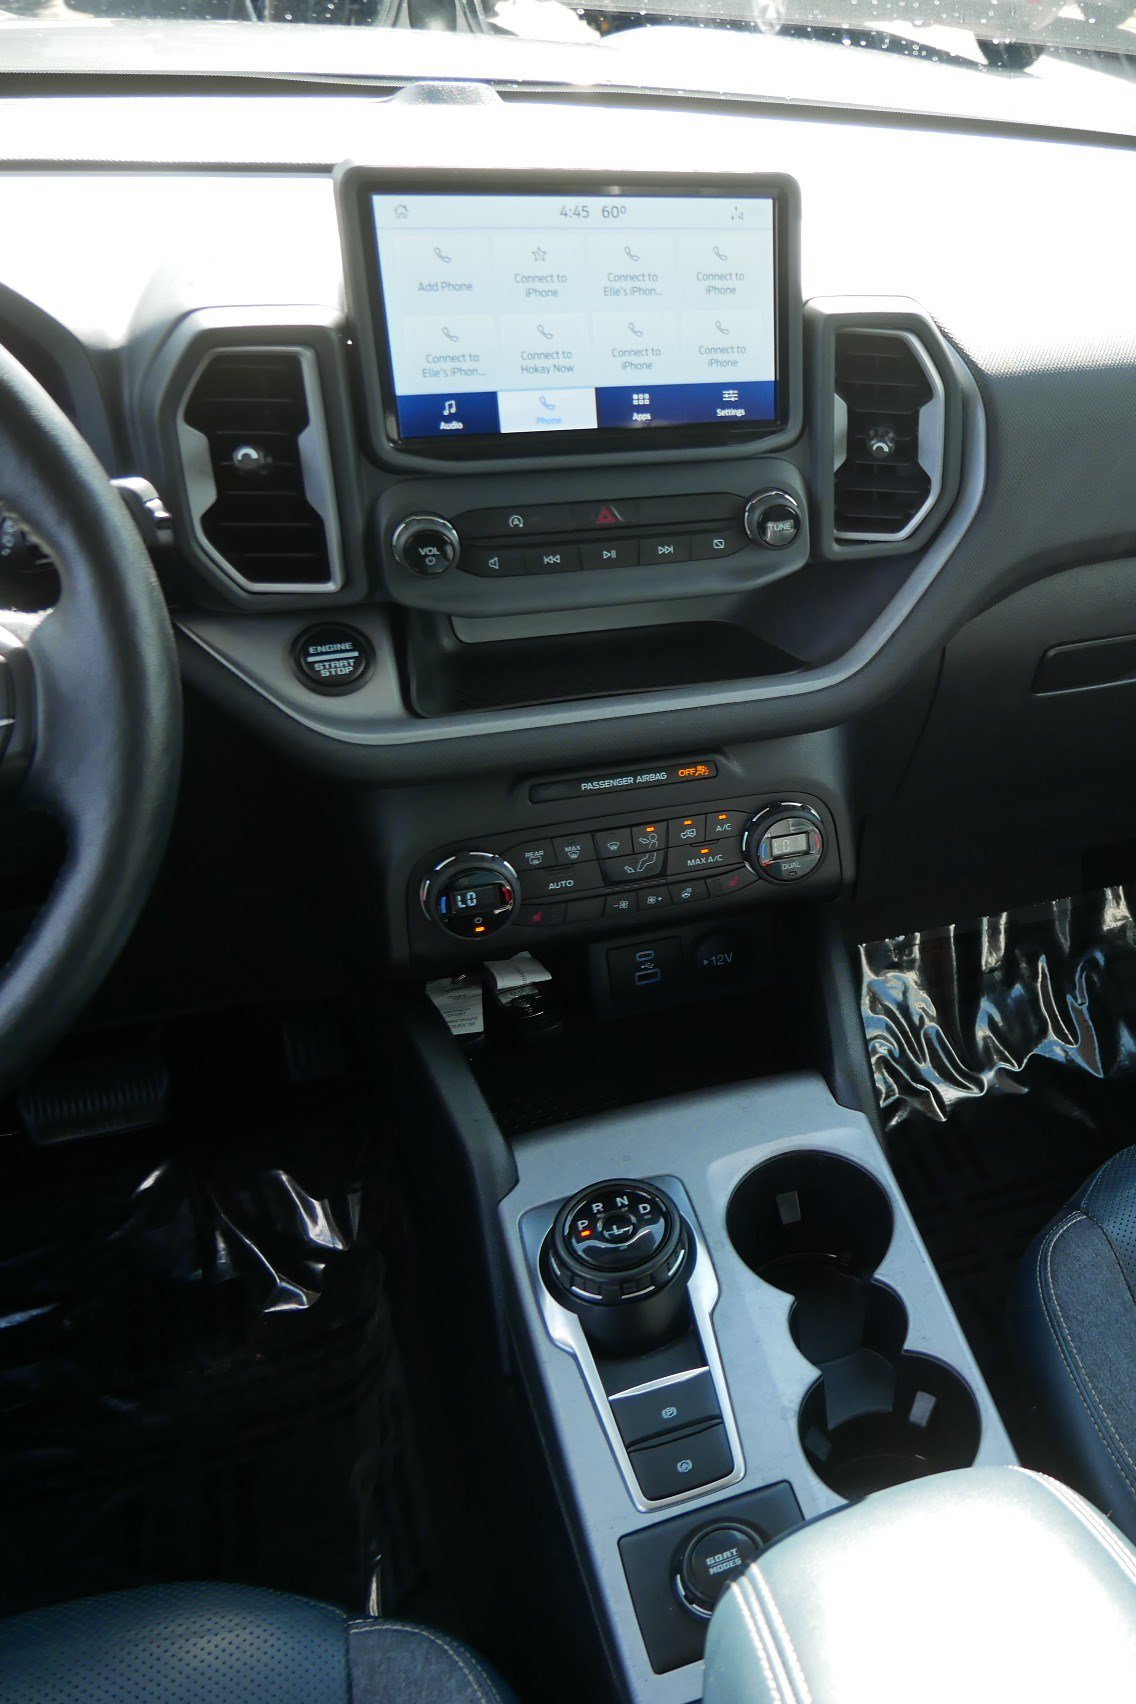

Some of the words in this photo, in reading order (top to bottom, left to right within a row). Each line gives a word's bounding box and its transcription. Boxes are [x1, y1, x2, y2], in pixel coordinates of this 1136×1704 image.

[560, 205, 590, 219] 4:45
[514, 273, 554, 284] Connect
[556, 273, 568, 283] to
[607, 272, 646, 283] Connect
[648, 272, 658, 282] to
[696, 271, 733, 282] Connect
[735, 271, 745, 281] to
[418, 282, 438, 292] Add
[440, 281, 473, 292] Phone
[603, 286, 628, 297] Elle's
[706, 285, 737, 295] iPhone
[525, 287, 559, 298] iPhone
[521, 350, 560, 361] Connect
[561, 350, 573, 360] to
[611, 348, 650, 358] Connect
[651, 347, 661, 357] to
[699, 345, 735, 355] Connect
[736, 345, 746, 354] to
[425, 354, 466, 364] Connect
[468, 353, 480, 363] to
[708, 358, 738, 368] iPhone
[521, 365, 550, 376] Hokay
[553, 364, 574, 374] Now
[621, 361, 653, 371] iPhone
[422, 368, 448, 379] Elle's
[632, 412, 652, 422] Apps
[716, 408, 746, 418] Settings
[440, 421, 464, 431] Audio
[536, 416, 562, 426] Phone
[767, 522, 791, 531] TUNE
[418, 547, 440, 556] VOL
[308, 642, 354, 654] ENGINE
[314, 659, 356, 671] START
[320, 666, 354, 677] STOP
[581, 776, 634, 791] PASSENGER
[636, 772, 667, 783] AIRBAG
[678, 767, 696, 777] OFF
[715, 823, 732, 832] A/C
[524, 850, 544, 858] REAR
[564, 844, 581, 853] MAX
[687, 857, 706, 867] MAX
[707, 854, 723, 863] A/C
[781, 861, 802, 871] DUAL
[548, 880, 574, 890] AUTO
[456, 891, 477, 908] LO
[710, 952, 733, 966] 12V
[616, 1195, 629, 1207] N
[592, 1203, 604, 1213] R
[638, 1203, 651, 1214] D
[577, 1220, 589, 1230] P
[708, 1557, 742, 1575] MODES
